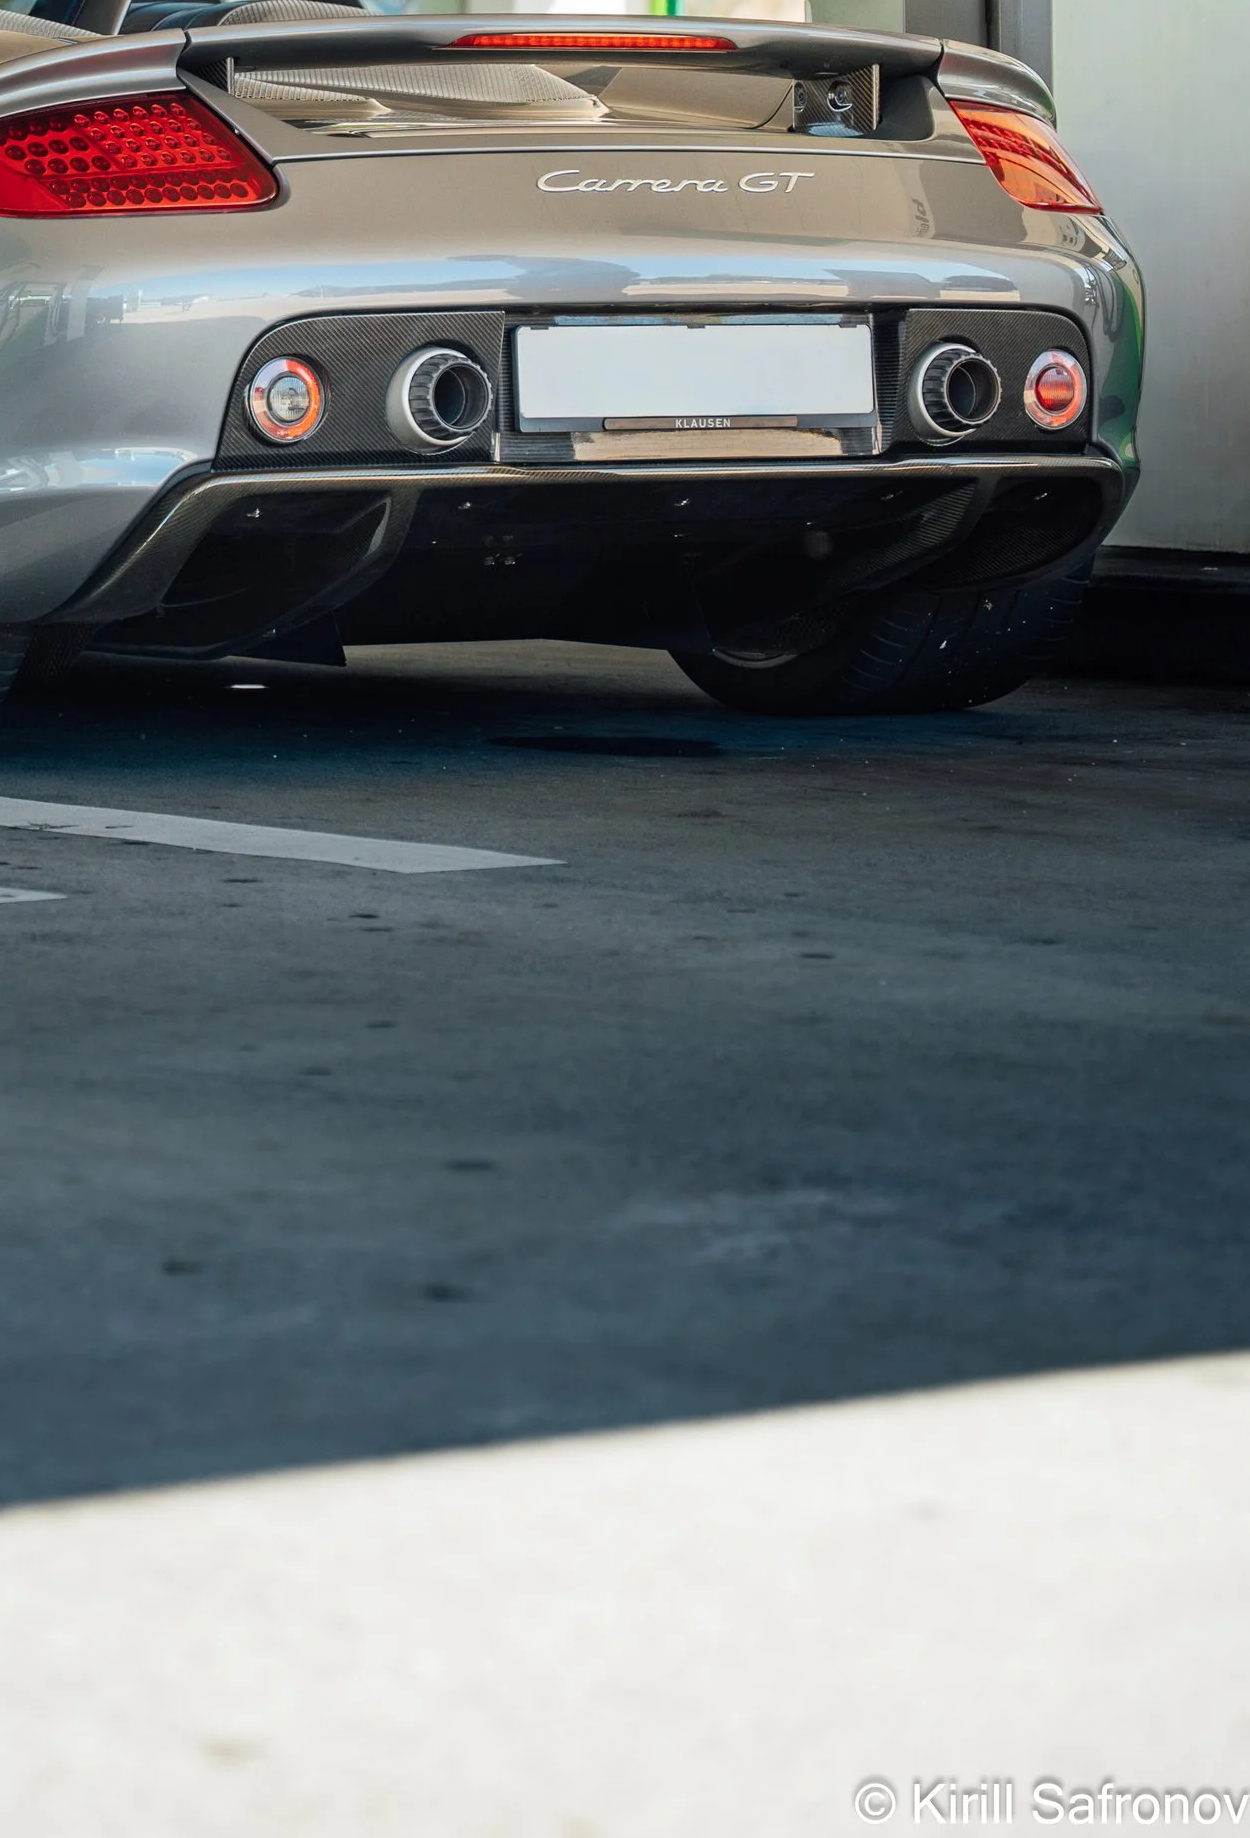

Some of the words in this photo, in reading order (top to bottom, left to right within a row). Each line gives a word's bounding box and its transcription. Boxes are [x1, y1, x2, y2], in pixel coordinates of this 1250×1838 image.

[536, 169, 729, 194] Carrera
[737, 171, 815, 194] GT
[674, 417, 732, 429] KLAUSEN
